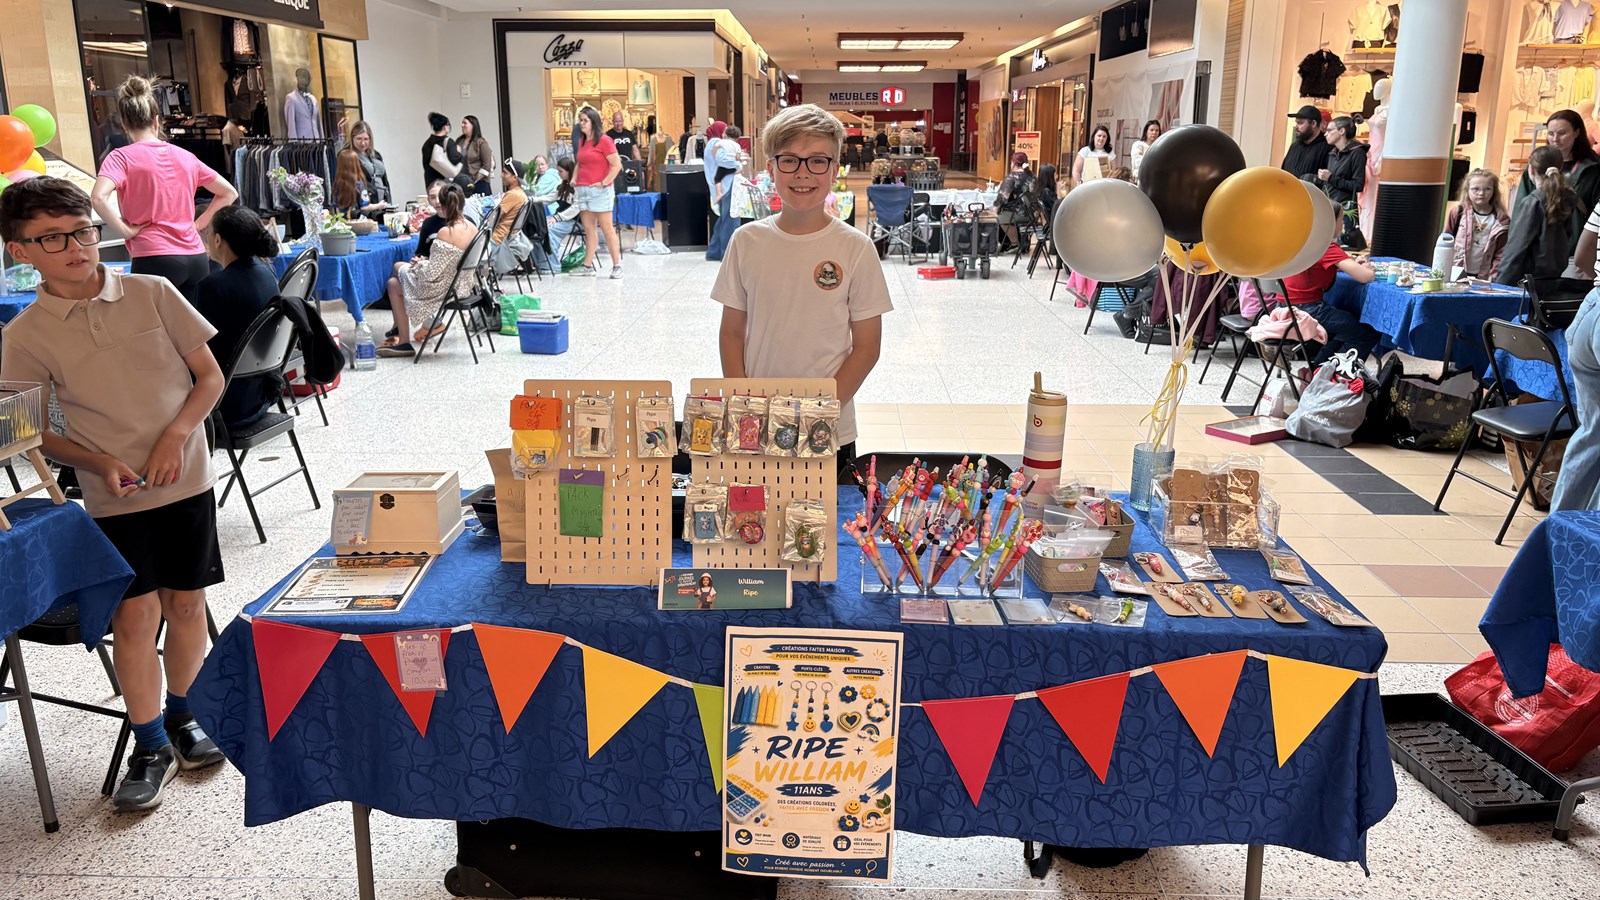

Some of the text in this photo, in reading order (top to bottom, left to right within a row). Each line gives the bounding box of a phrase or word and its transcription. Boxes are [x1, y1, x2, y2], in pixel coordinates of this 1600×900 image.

[829, 90, 903, 104] MEUBLES RD
[767, 736, 849, 760] RIPE
[754, 760, 868, 783] WILLIAM
[794, 786, 823, 795] 11ANS
